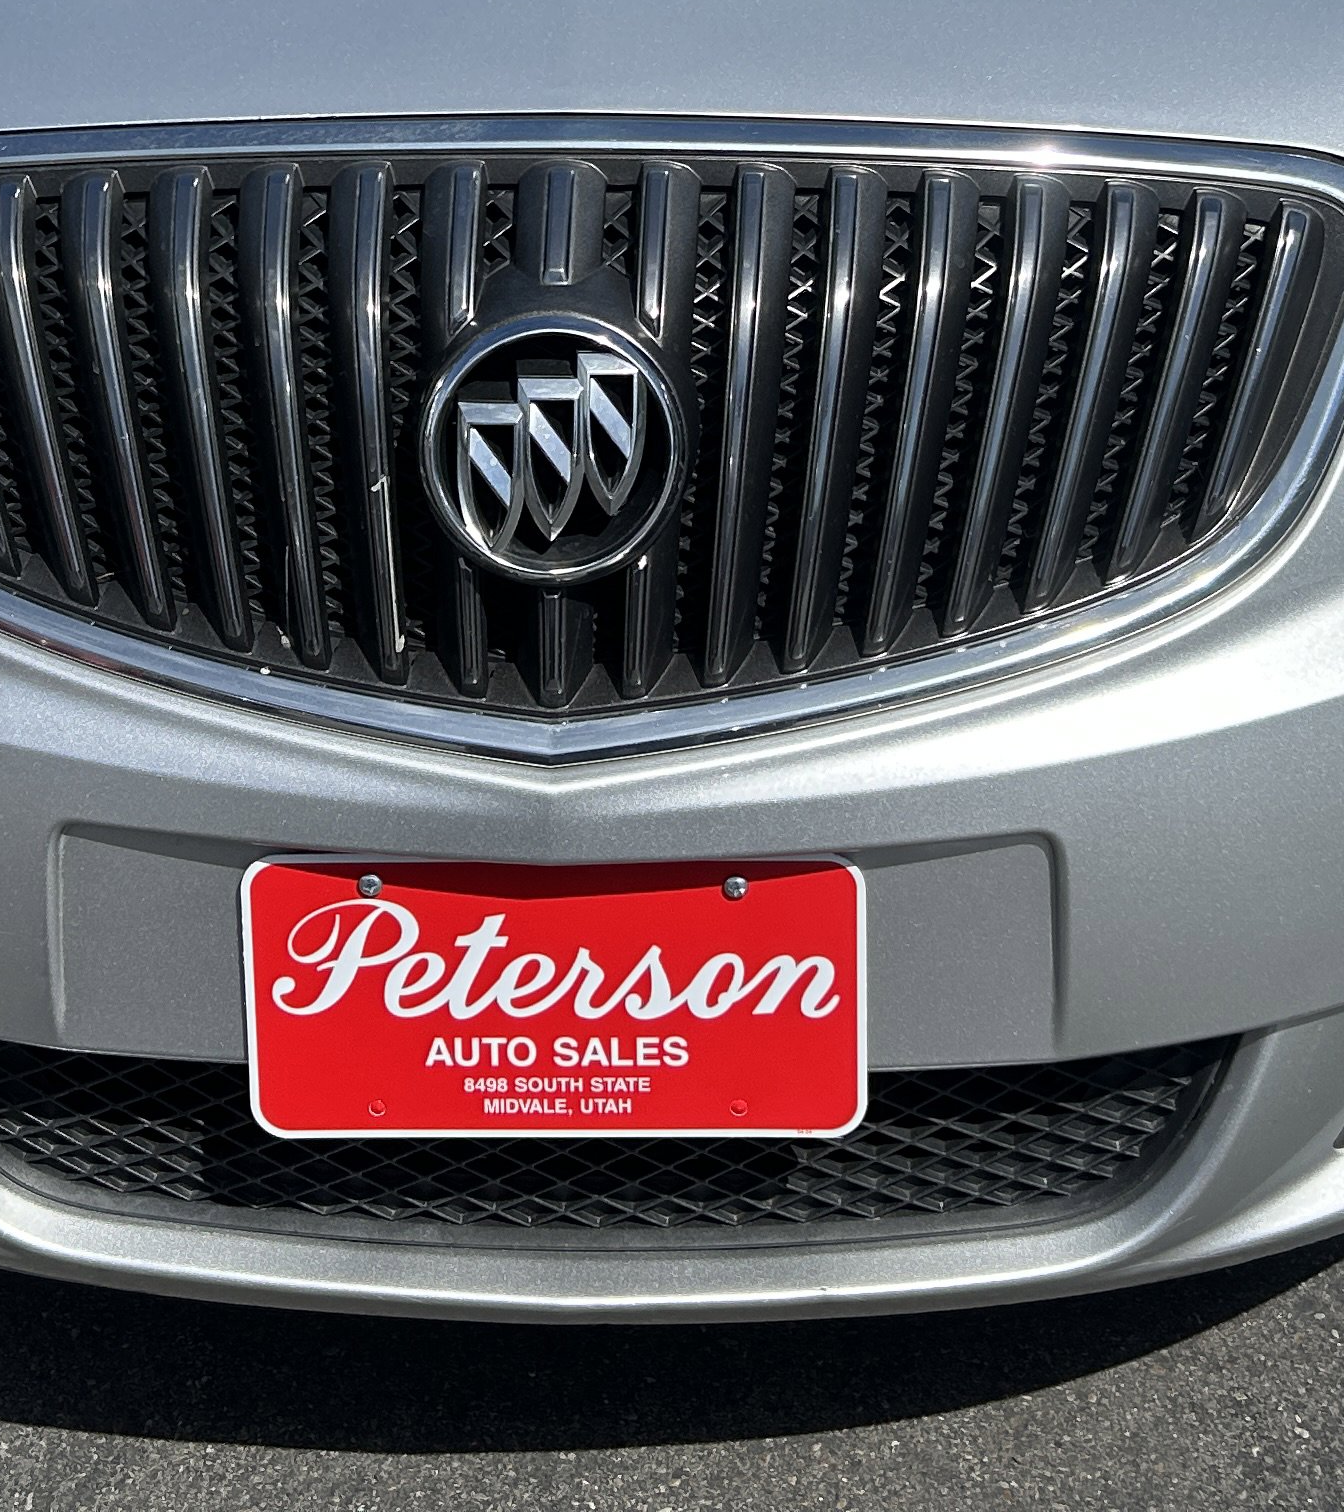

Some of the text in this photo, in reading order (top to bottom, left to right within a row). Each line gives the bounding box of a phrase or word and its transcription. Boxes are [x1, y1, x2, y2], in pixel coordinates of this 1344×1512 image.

[270, 897, 842, 1021] Peterson
[424, 1035, 690, 1068] AUTO SALES
[463, 1076, 651, 1093] 8498 SOUTH STATE
[483, 1097, 632, 1116] MIDVALE, UTAH
